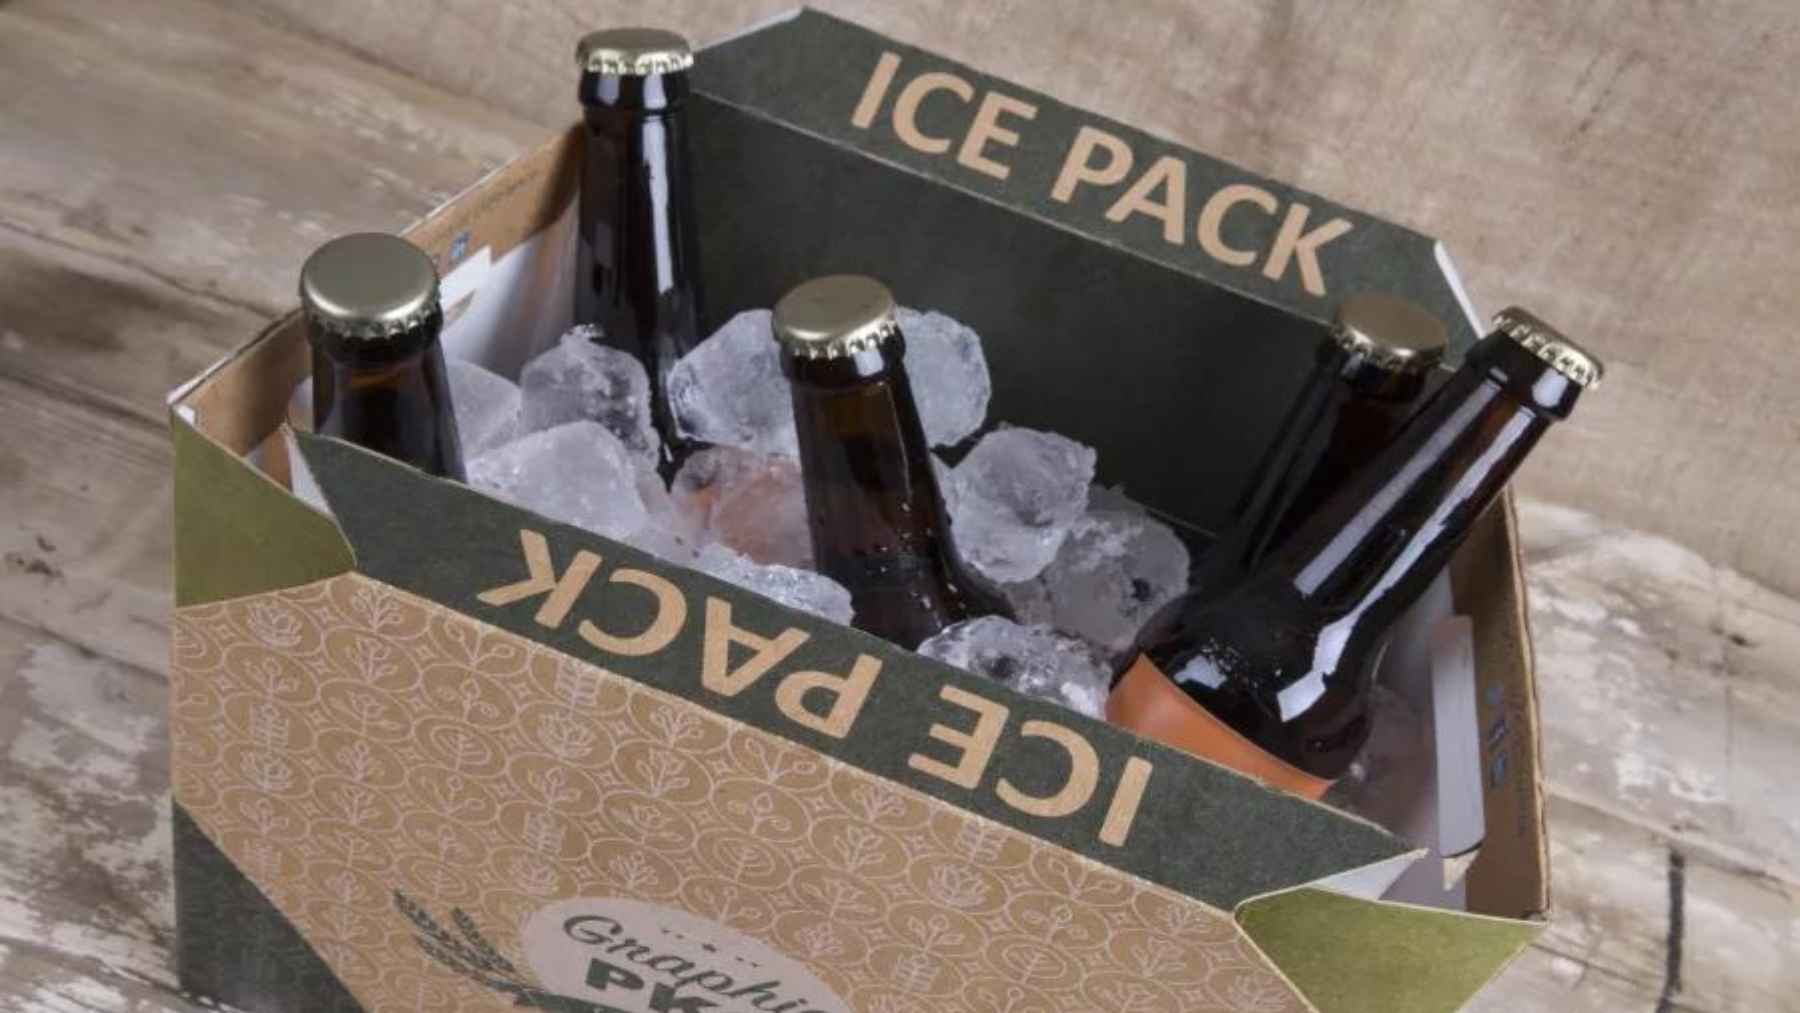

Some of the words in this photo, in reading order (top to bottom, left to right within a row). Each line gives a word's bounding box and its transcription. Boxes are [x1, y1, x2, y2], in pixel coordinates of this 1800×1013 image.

[851, 51, 1038, 180] ICE
[1051, 126, 1354, 297] PACK
[477, 529, 883, 739] PACK
[908, 685, 1153, 847] ICE
[563, 914, 828, 1013] Graphi
